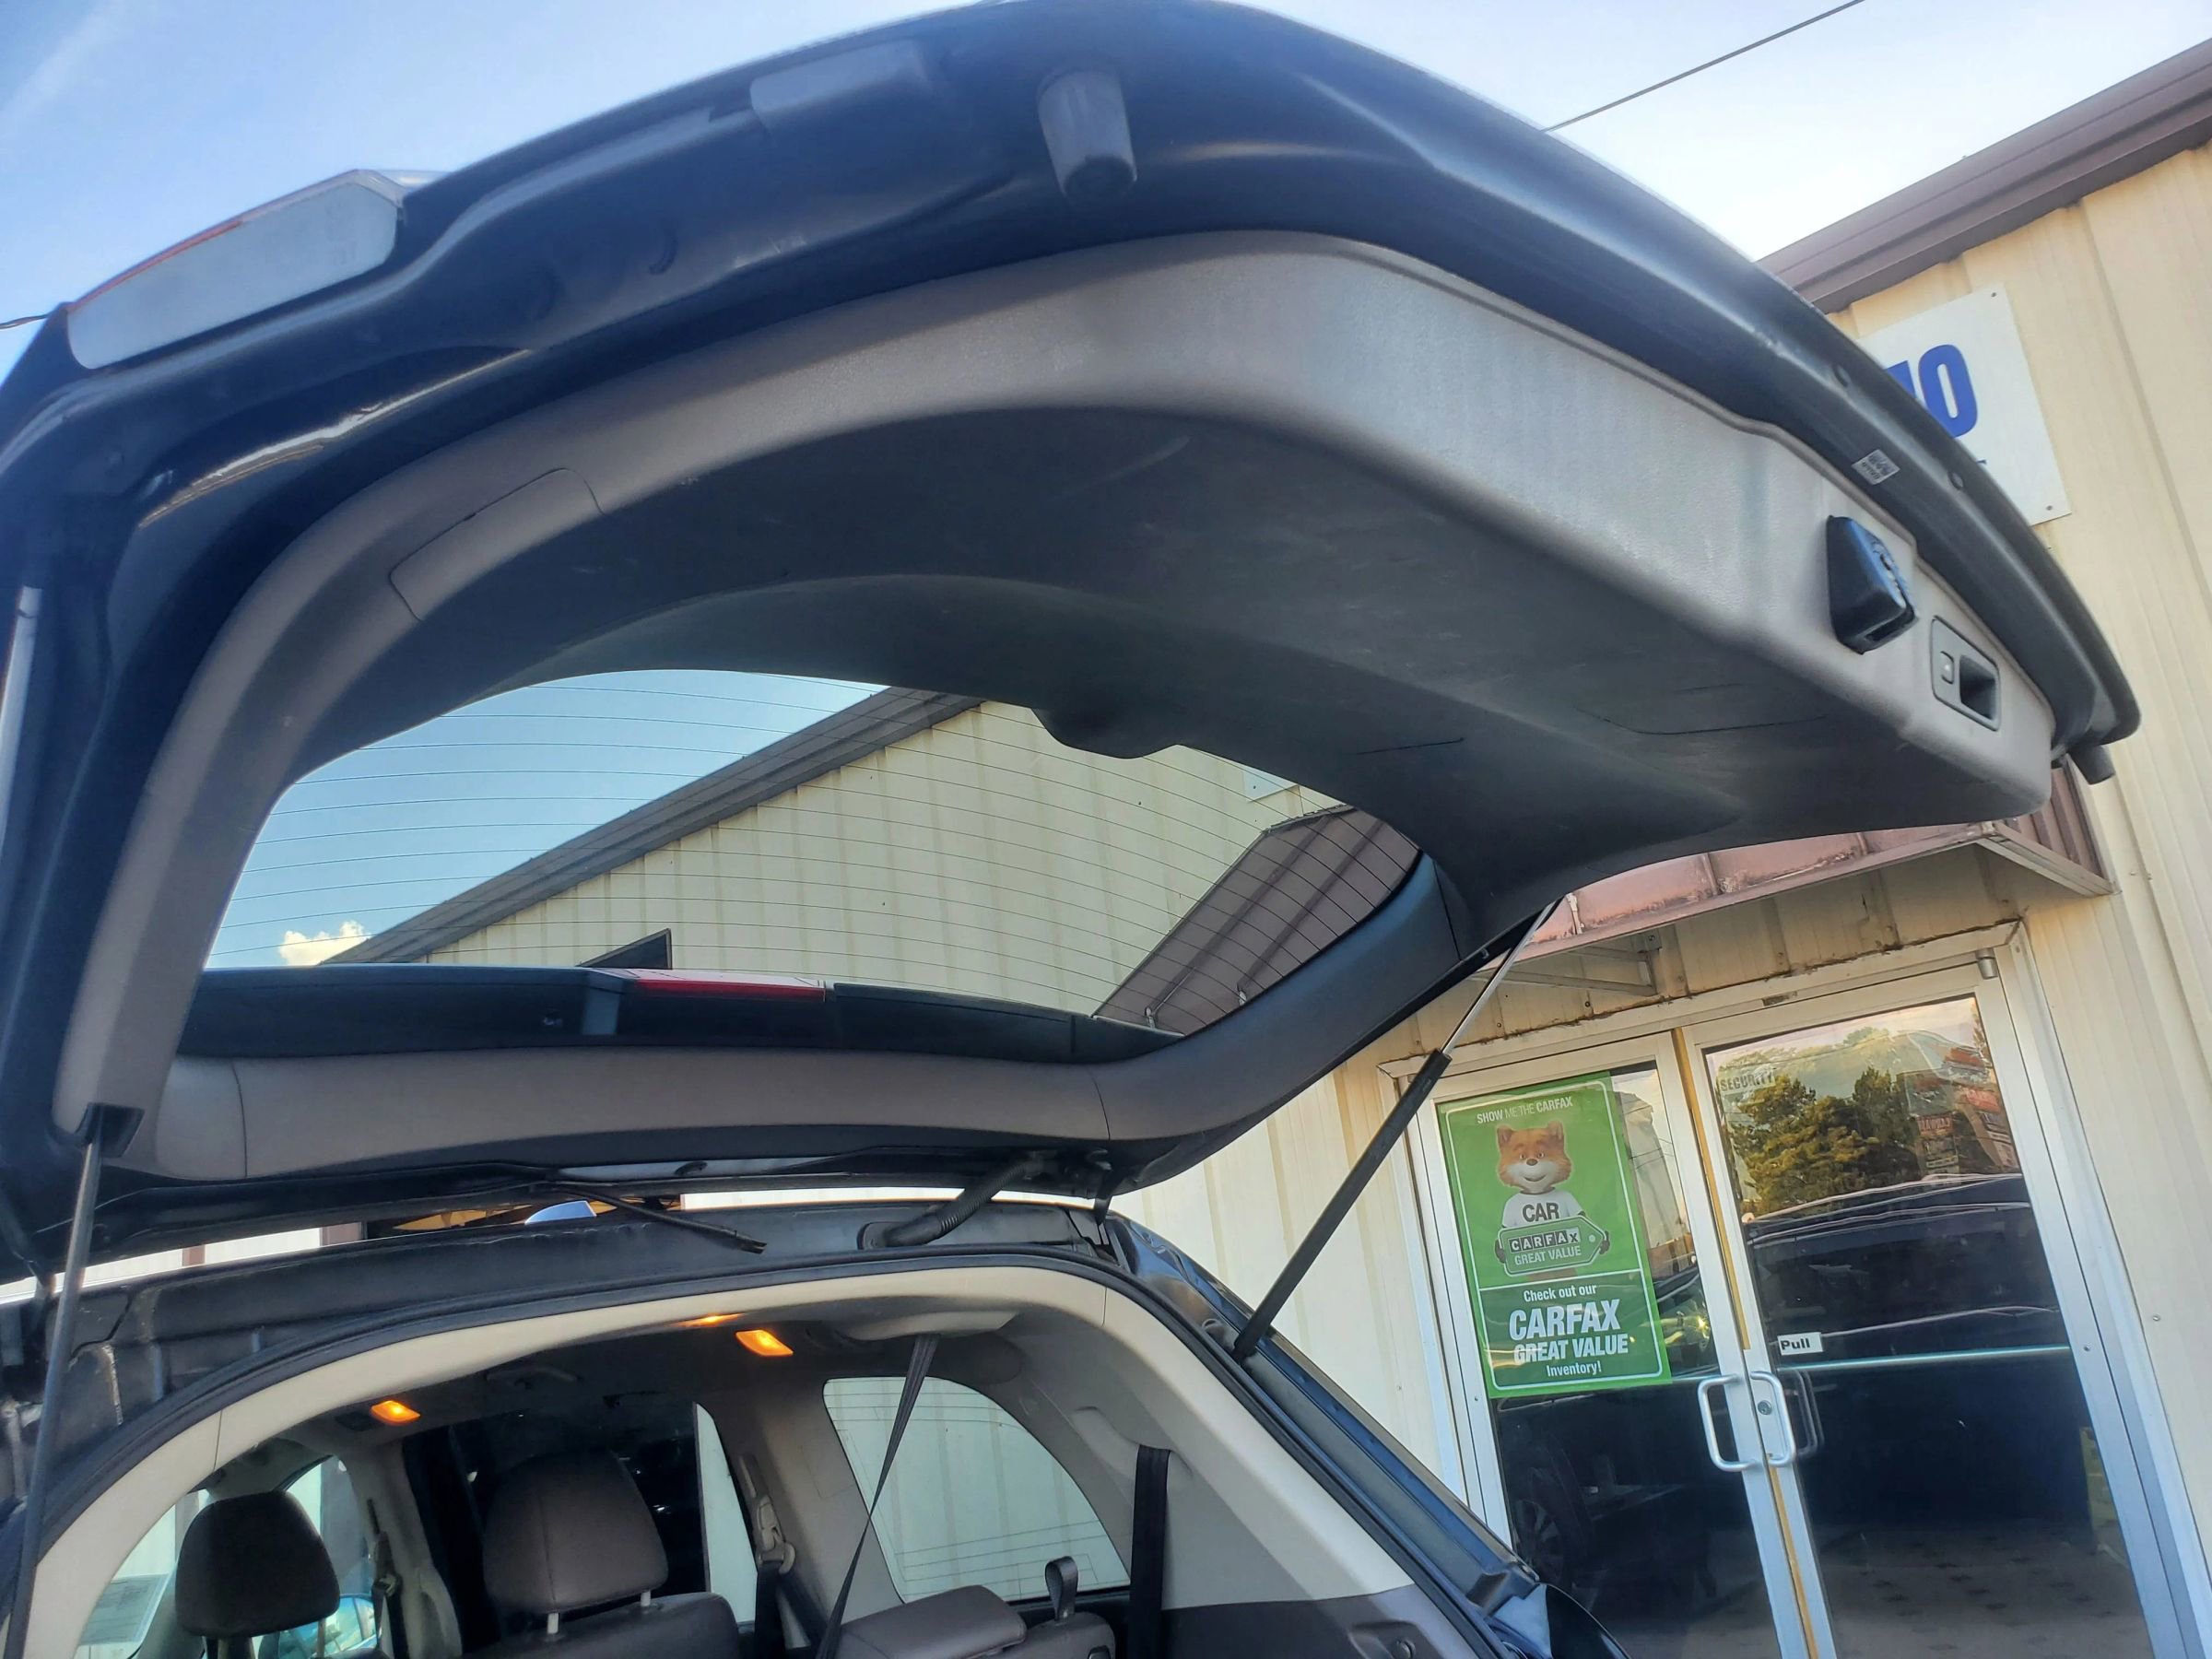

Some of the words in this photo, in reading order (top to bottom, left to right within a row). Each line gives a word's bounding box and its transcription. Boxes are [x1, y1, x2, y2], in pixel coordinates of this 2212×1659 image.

[1477, 1110, 1503, 1124] SHOW
[1504, 1107, 1518, 1118] ME
[1519, 1103, 1535, 1115] THE
[1535, 1096, 1573, 1112] CARFAX
[1522, 1202, 1559, 1222] CAR
[1510, 1231, 1579, 1253] CARFAX
[1514, 1251, 1547, 1265] GREAT
[1548, 1245, 1582, 1261] VALUE
[1523, 1288, 1556, 1302] Check
[1559, 1286, 1576, 1298] out
[1579, 1285, 1597, 1295] our
[1509, 1299, 1621, 1340] CARFAX
[1513, 1339, 1569, 1362] GREAT
[1571, 1333, 1629, 1359] VALUE
[1780, 1337, 1810, 1350] Pull
[1546, 1359, 1602, 1377] Inventory!
